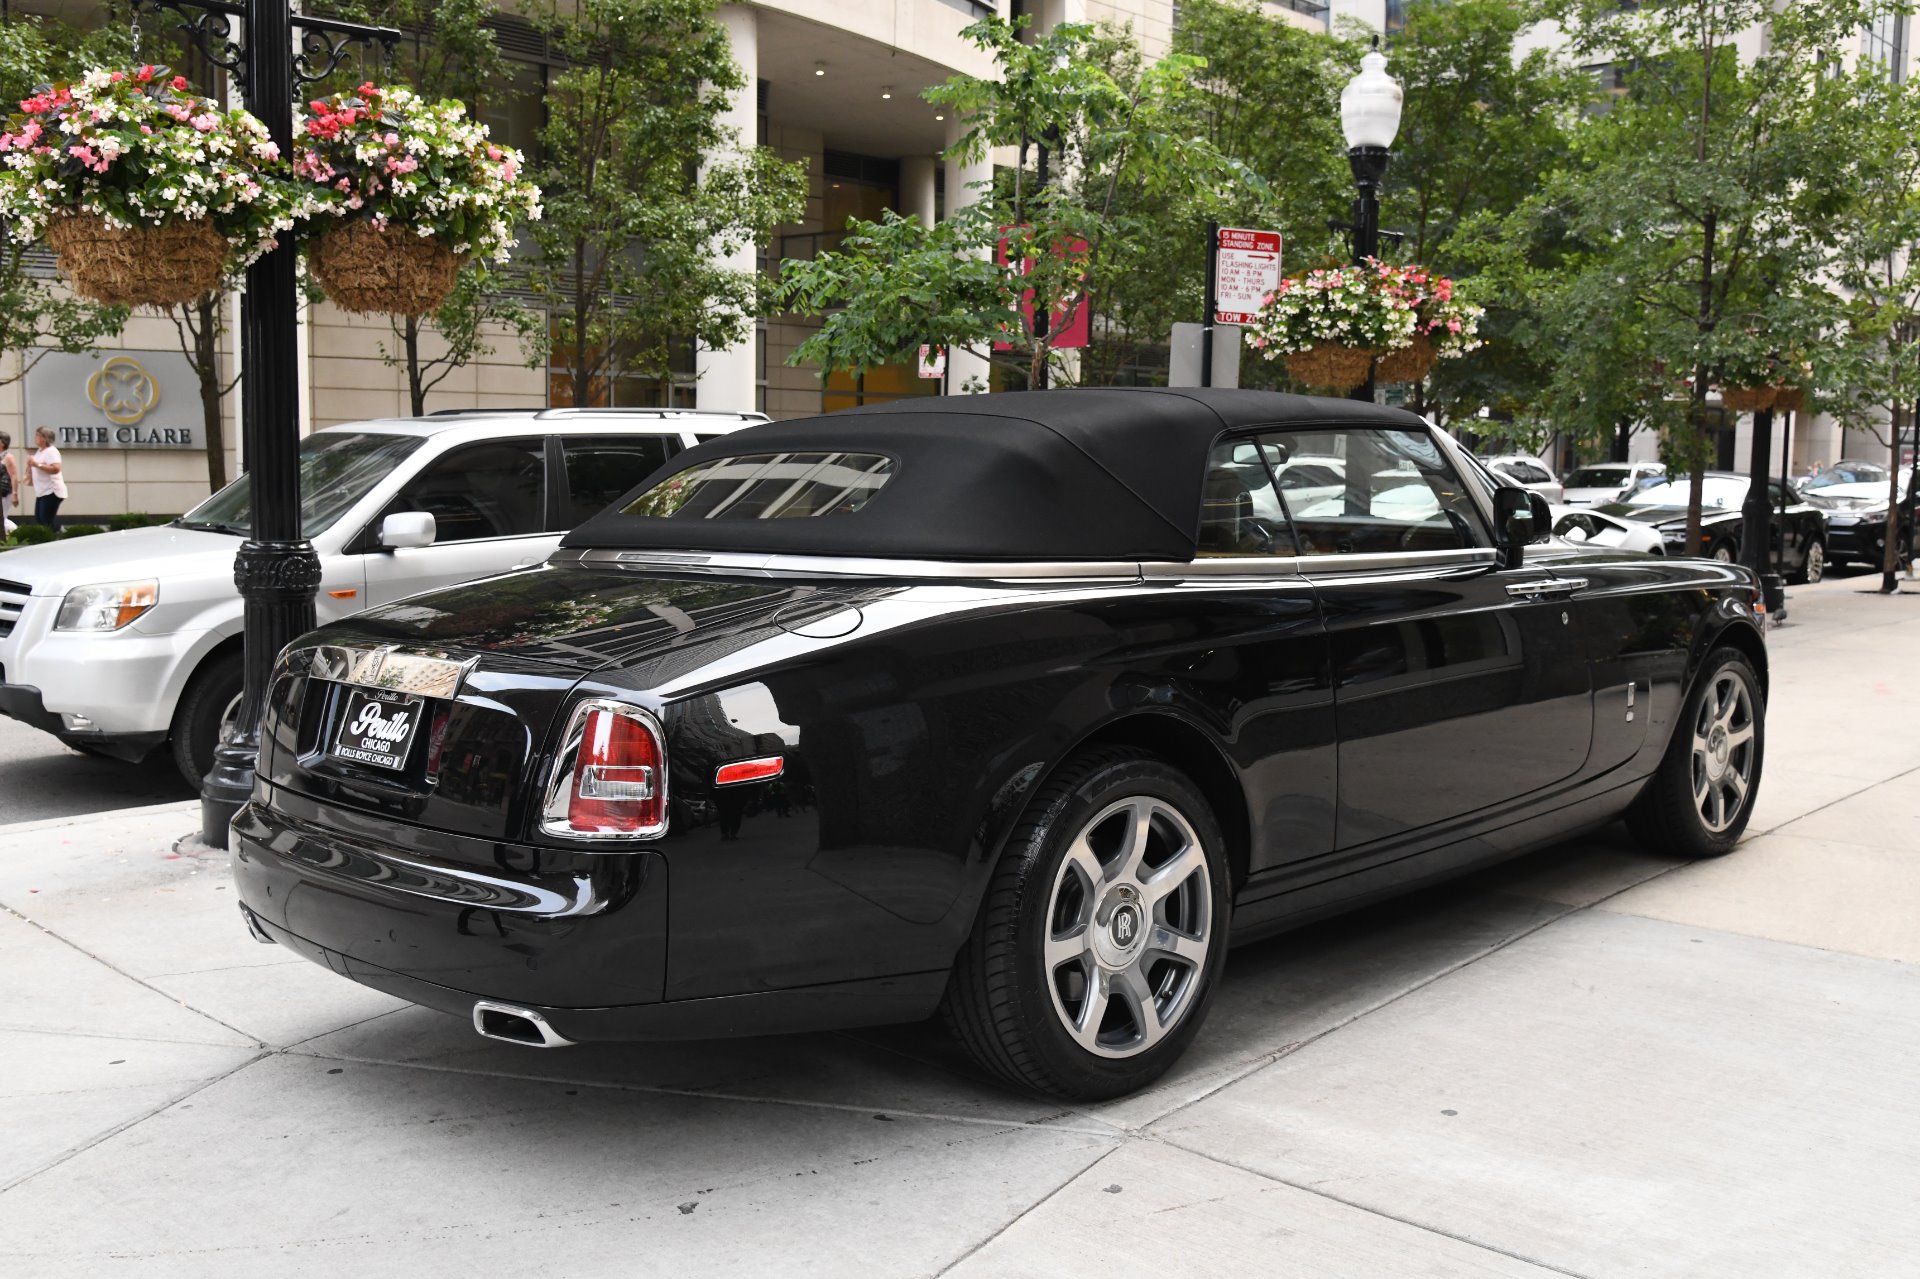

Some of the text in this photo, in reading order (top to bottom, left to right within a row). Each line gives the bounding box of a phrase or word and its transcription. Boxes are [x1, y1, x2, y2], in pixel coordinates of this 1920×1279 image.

[1222, 231, 1255, 241] 15 MINUTE
[1222, 240, 1274, 251] STANDING ZONE
[1221, 252, 1234, 260] USE
[1221, 260, 1276, 271] FLASHING LIGHTS
[1243, 277, 1265, 286] THURS
[1220, 312, 1241, 322] TOW
[59, 427, 192, 444] THE CLARE
[350, 702, 410, 743] Perillo
[361, 737, 391, 753] CHICAGO
[341, 747, 393, 765] ROLLS ROYCE CHICAGO
